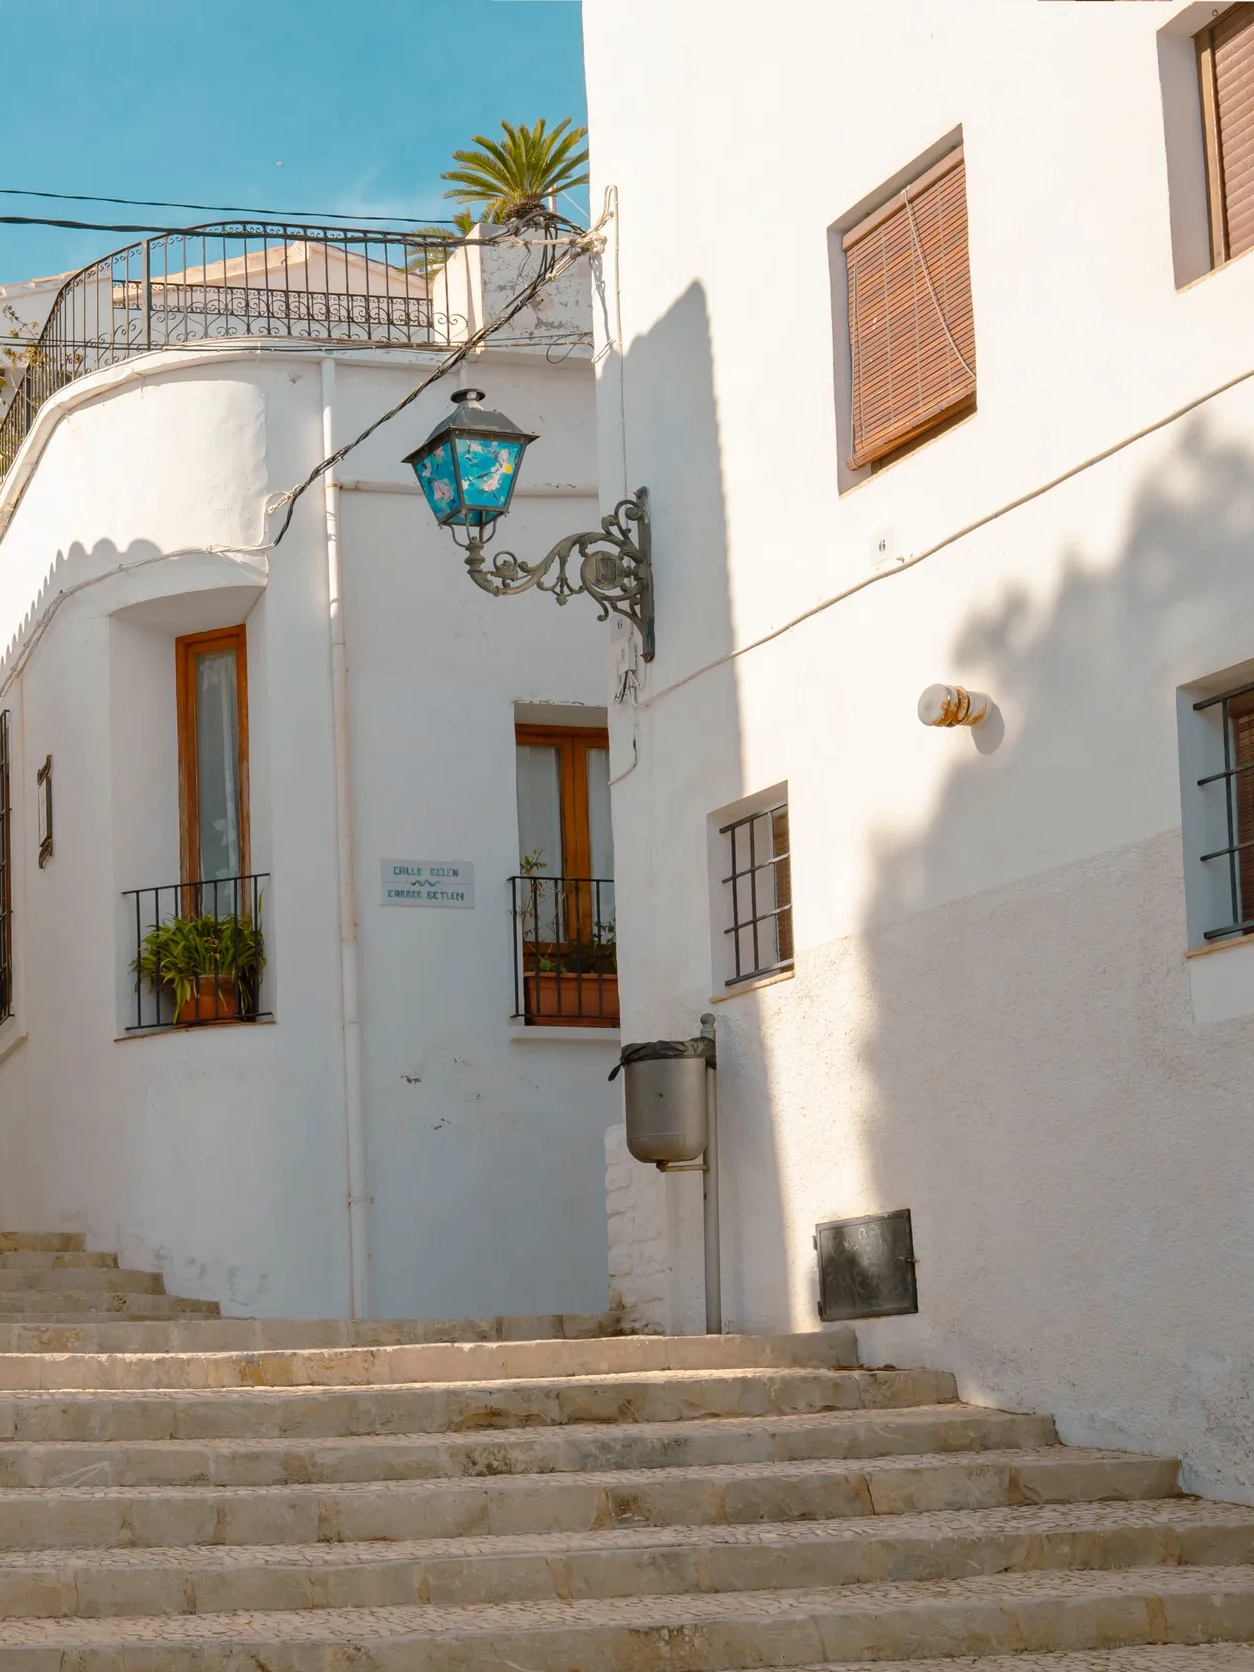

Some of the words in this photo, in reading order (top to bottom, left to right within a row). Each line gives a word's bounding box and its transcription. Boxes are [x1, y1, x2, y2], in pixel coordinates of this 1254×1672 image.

[393, 866, 423, 876] CALLE
[429, 868, 460, 878] BELEN
[387, 889, 423, 899] CARRER
